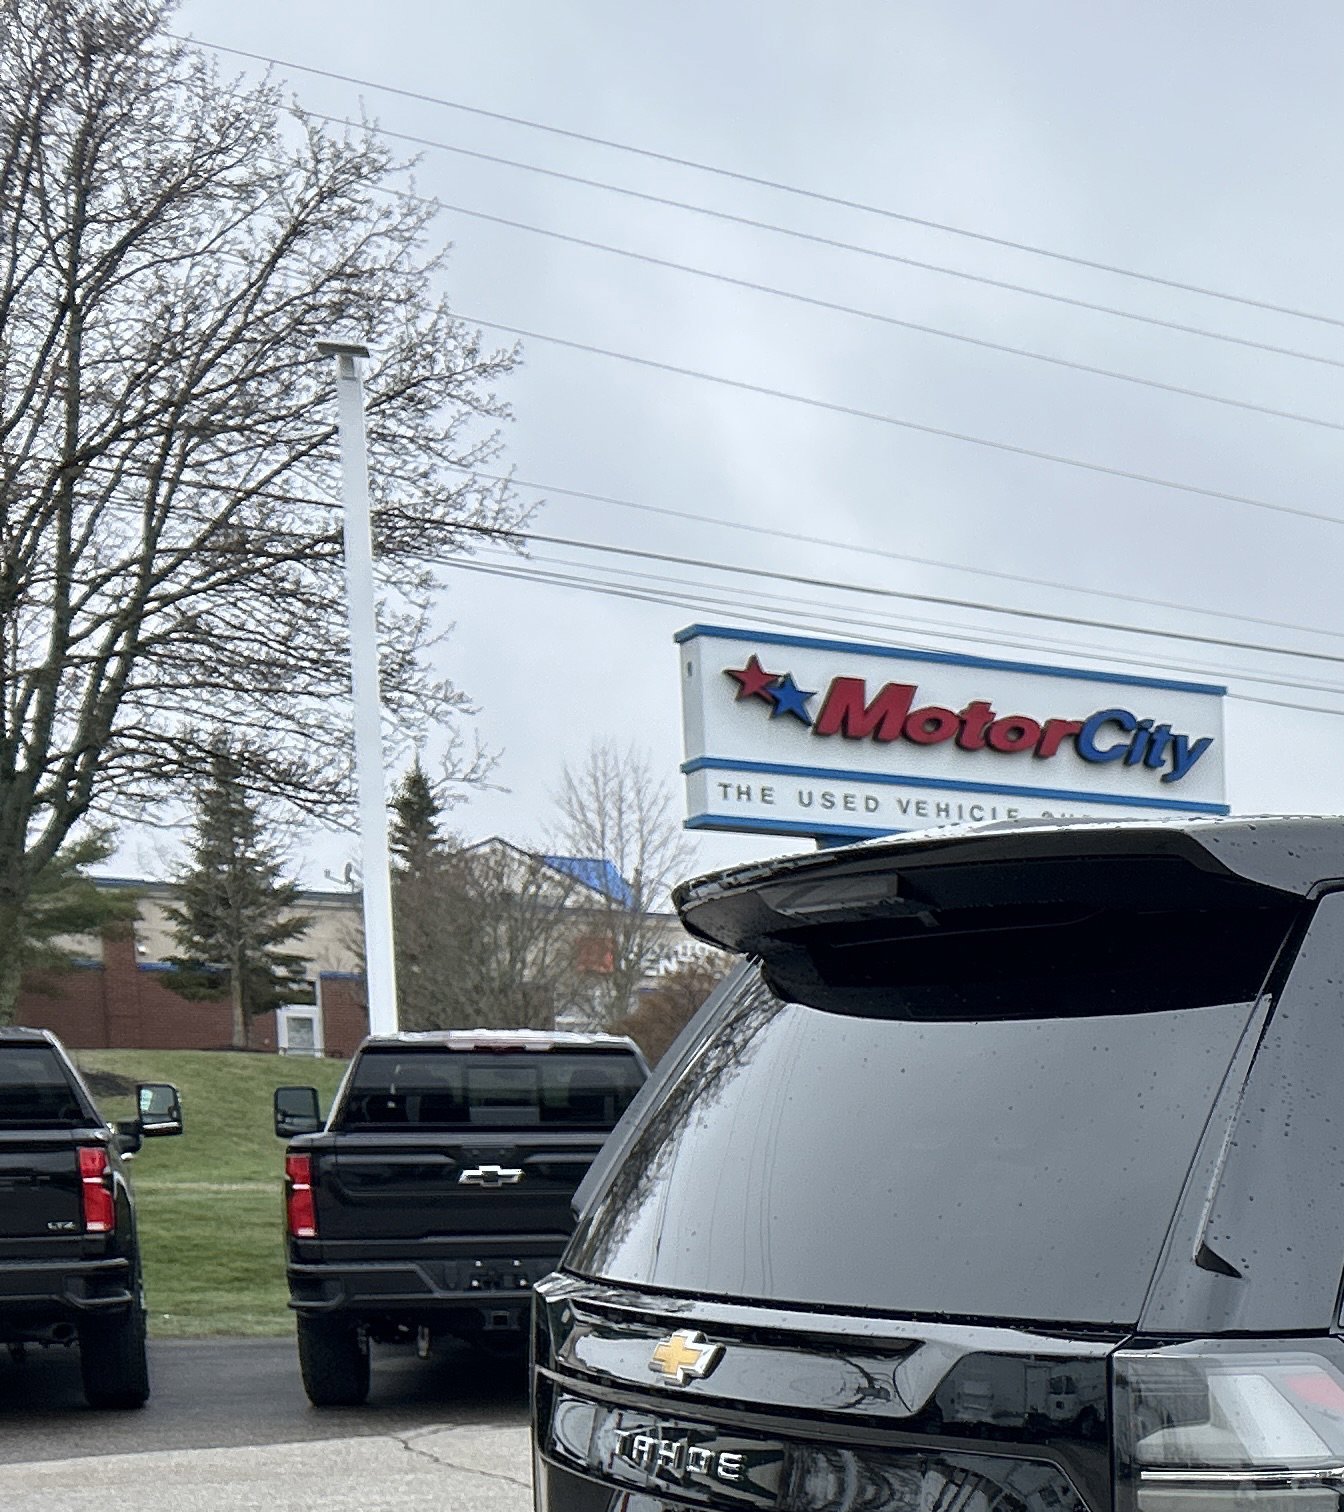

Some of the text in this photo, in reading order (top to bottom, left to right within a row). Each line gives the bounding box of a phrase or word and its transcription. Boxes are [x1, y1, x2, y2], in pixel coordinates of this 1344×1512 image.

[812, 676, 1213, 782] MotorCity
[718, 782, 775, 805] THE
[798, 789, 880, 814] USED
[614, 1429, 747, 1482] TAHOE
